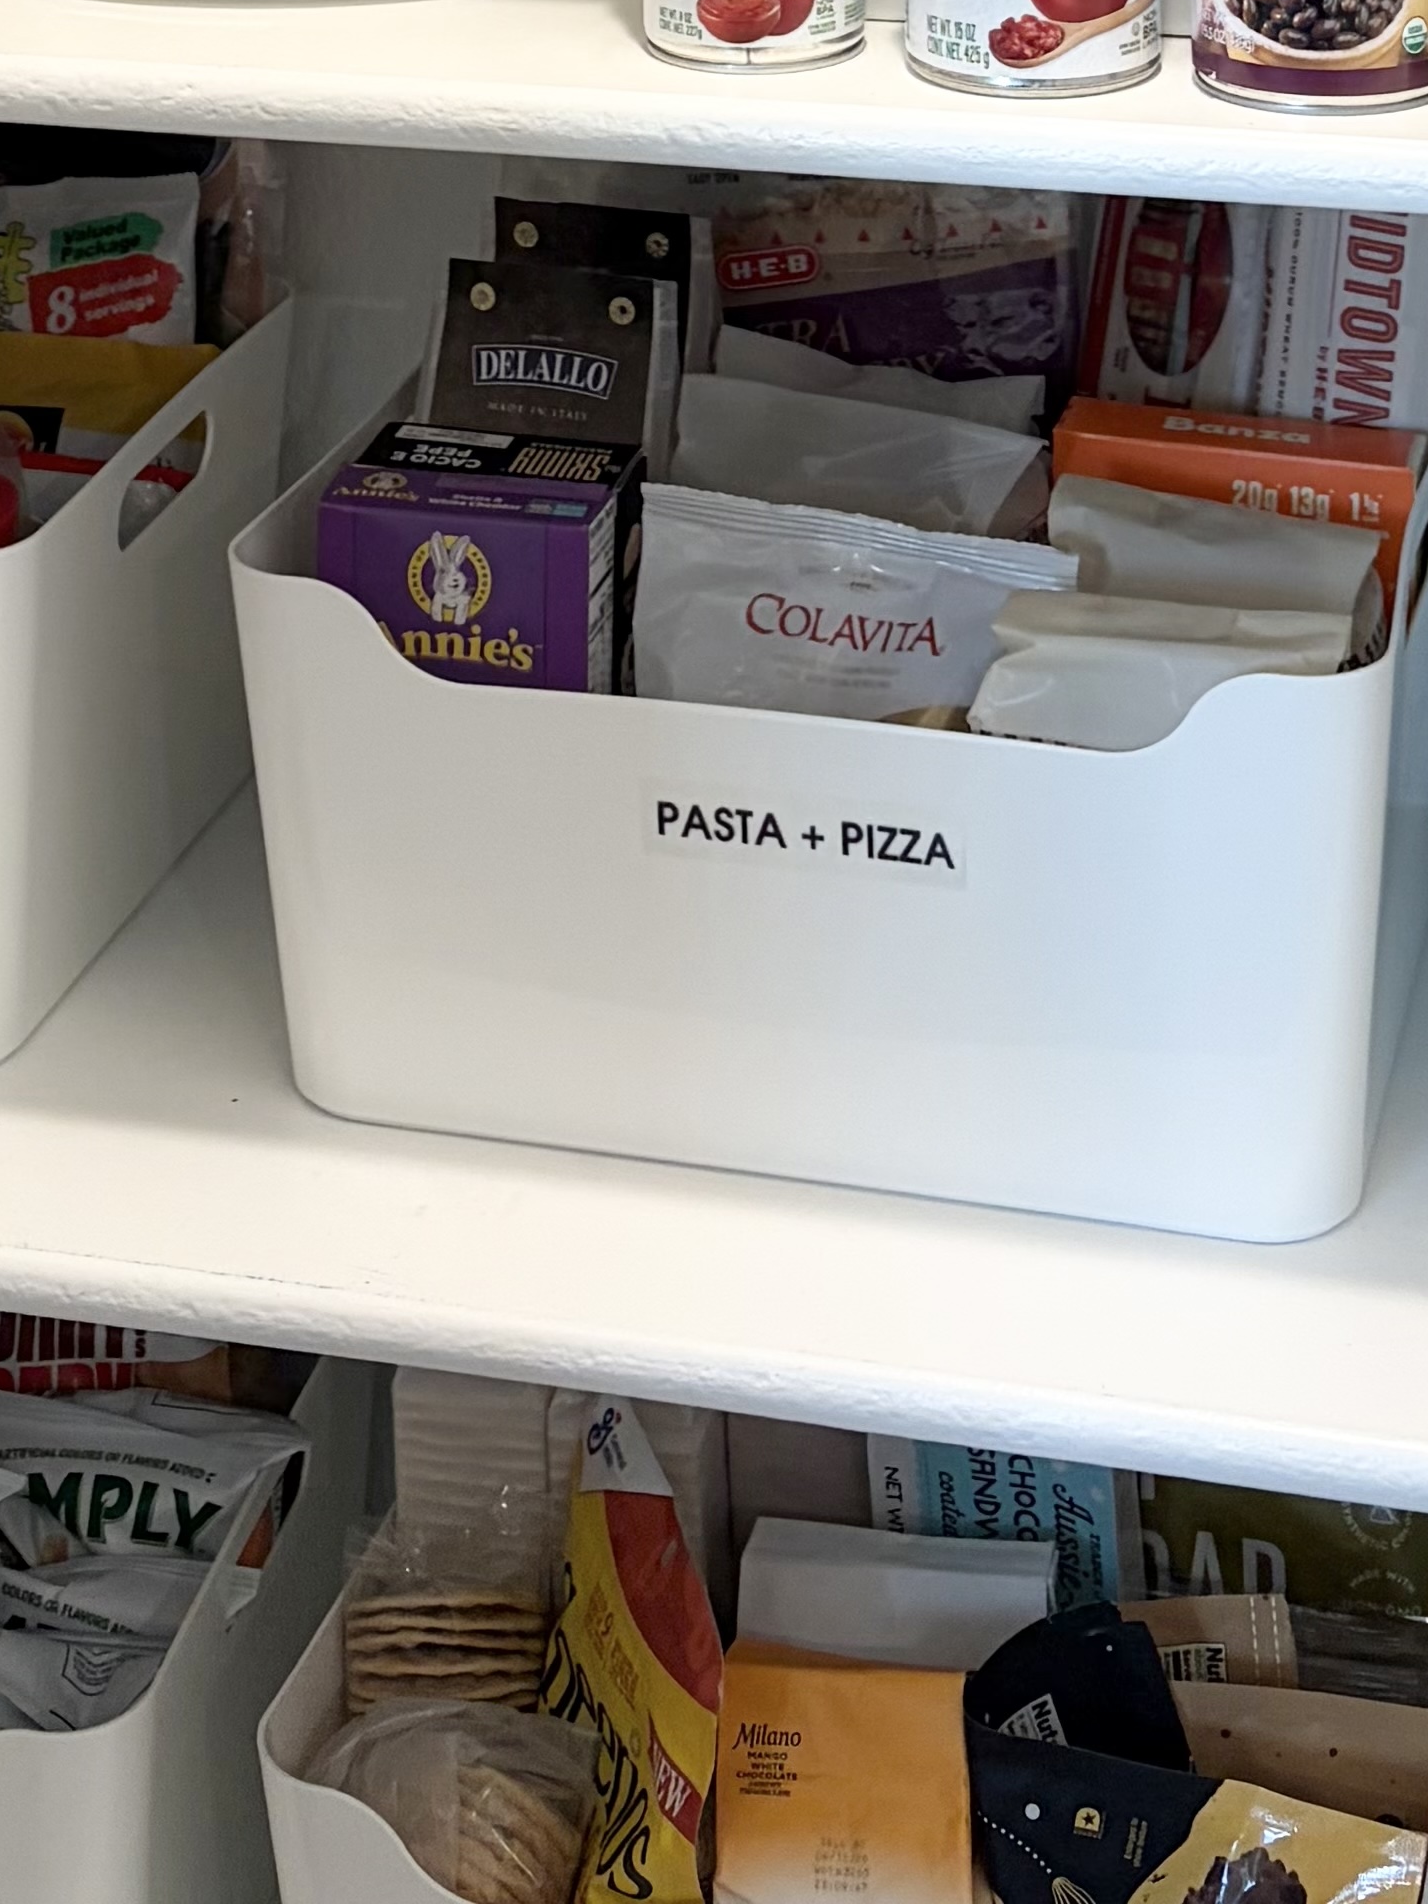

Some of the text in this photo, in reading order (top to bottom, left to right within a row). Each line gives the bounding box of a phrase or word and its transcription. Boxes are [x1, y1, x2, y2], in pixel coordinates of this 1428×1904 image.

[478, 348, 609, 392] DELALLO
[745, 592, 943, 656] COLAVITA
[656, 800, 956, 869] PASTA + PIZZA
[734, 1721, 803, 1752] Milano
